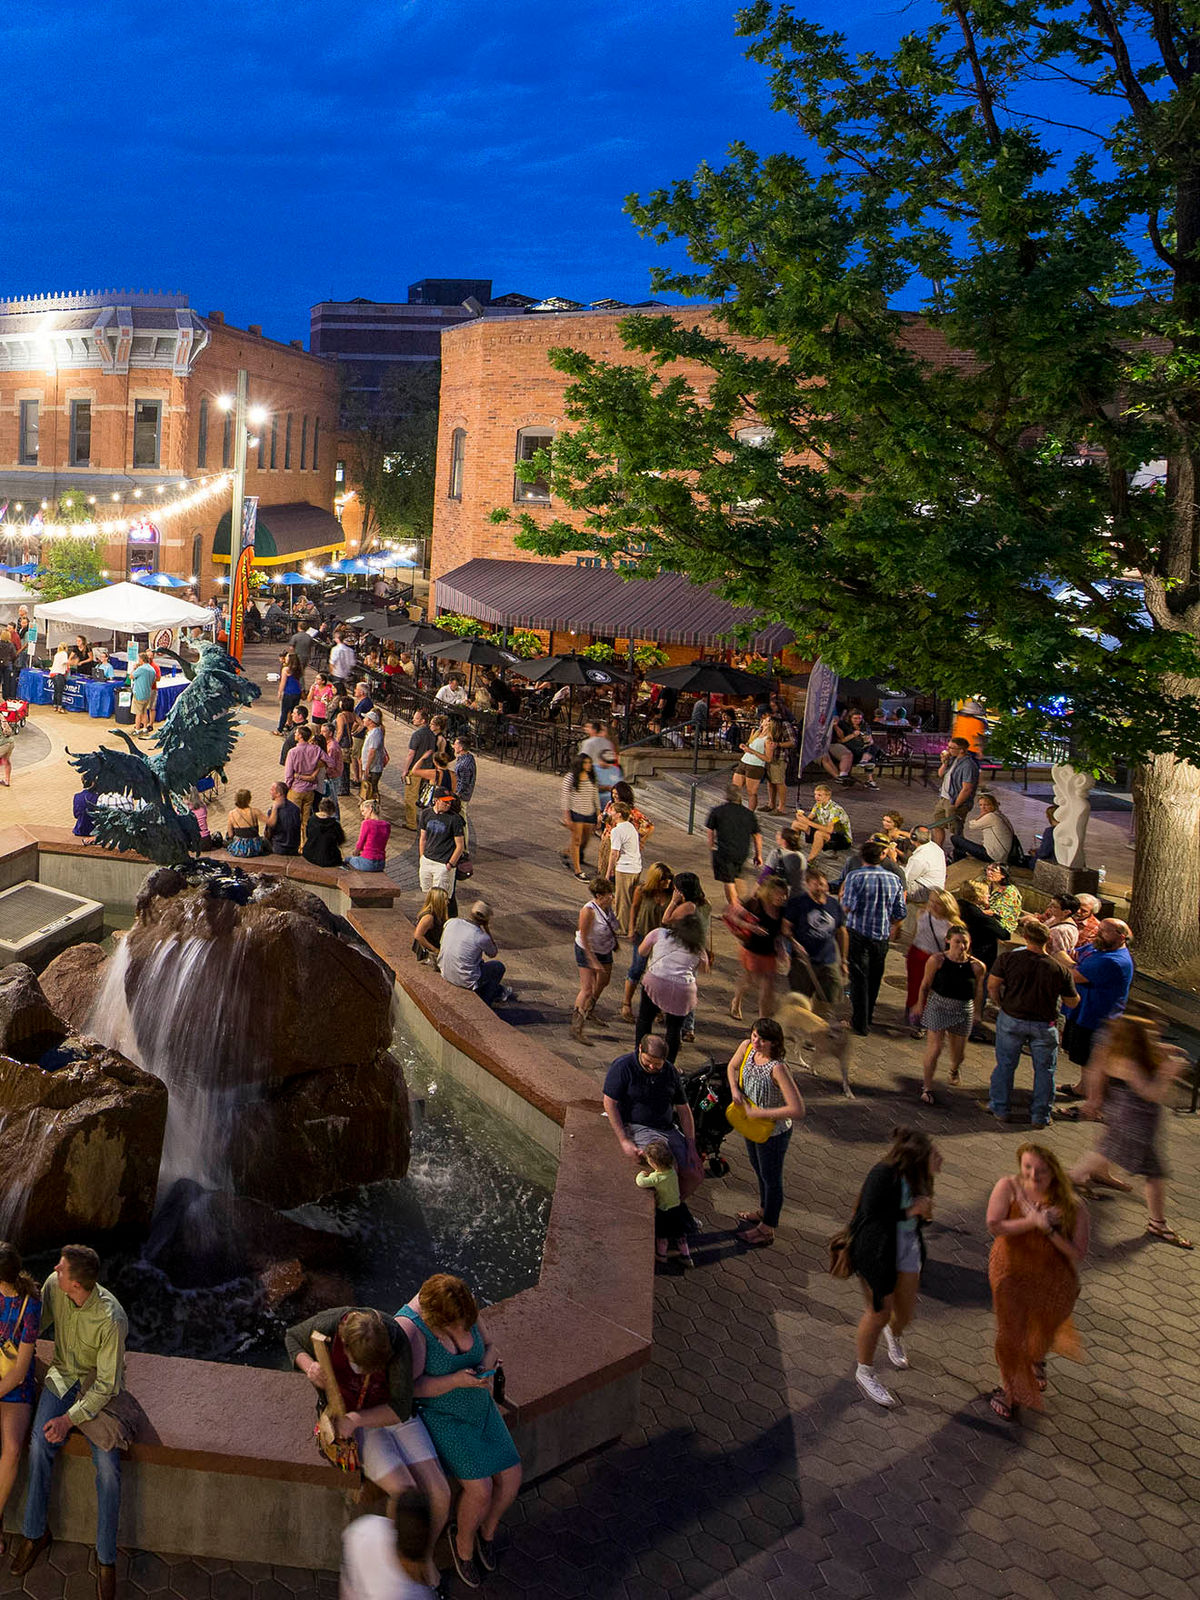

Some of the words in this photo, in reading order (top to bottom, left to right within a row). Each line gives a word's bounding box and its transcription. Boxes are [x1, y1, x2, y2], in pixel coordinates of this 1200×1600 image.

[576, 556, 601, 568] PUB
[234, 555, 248, 641] EVRAGES
[46, 679, 81, 693] Wome!
